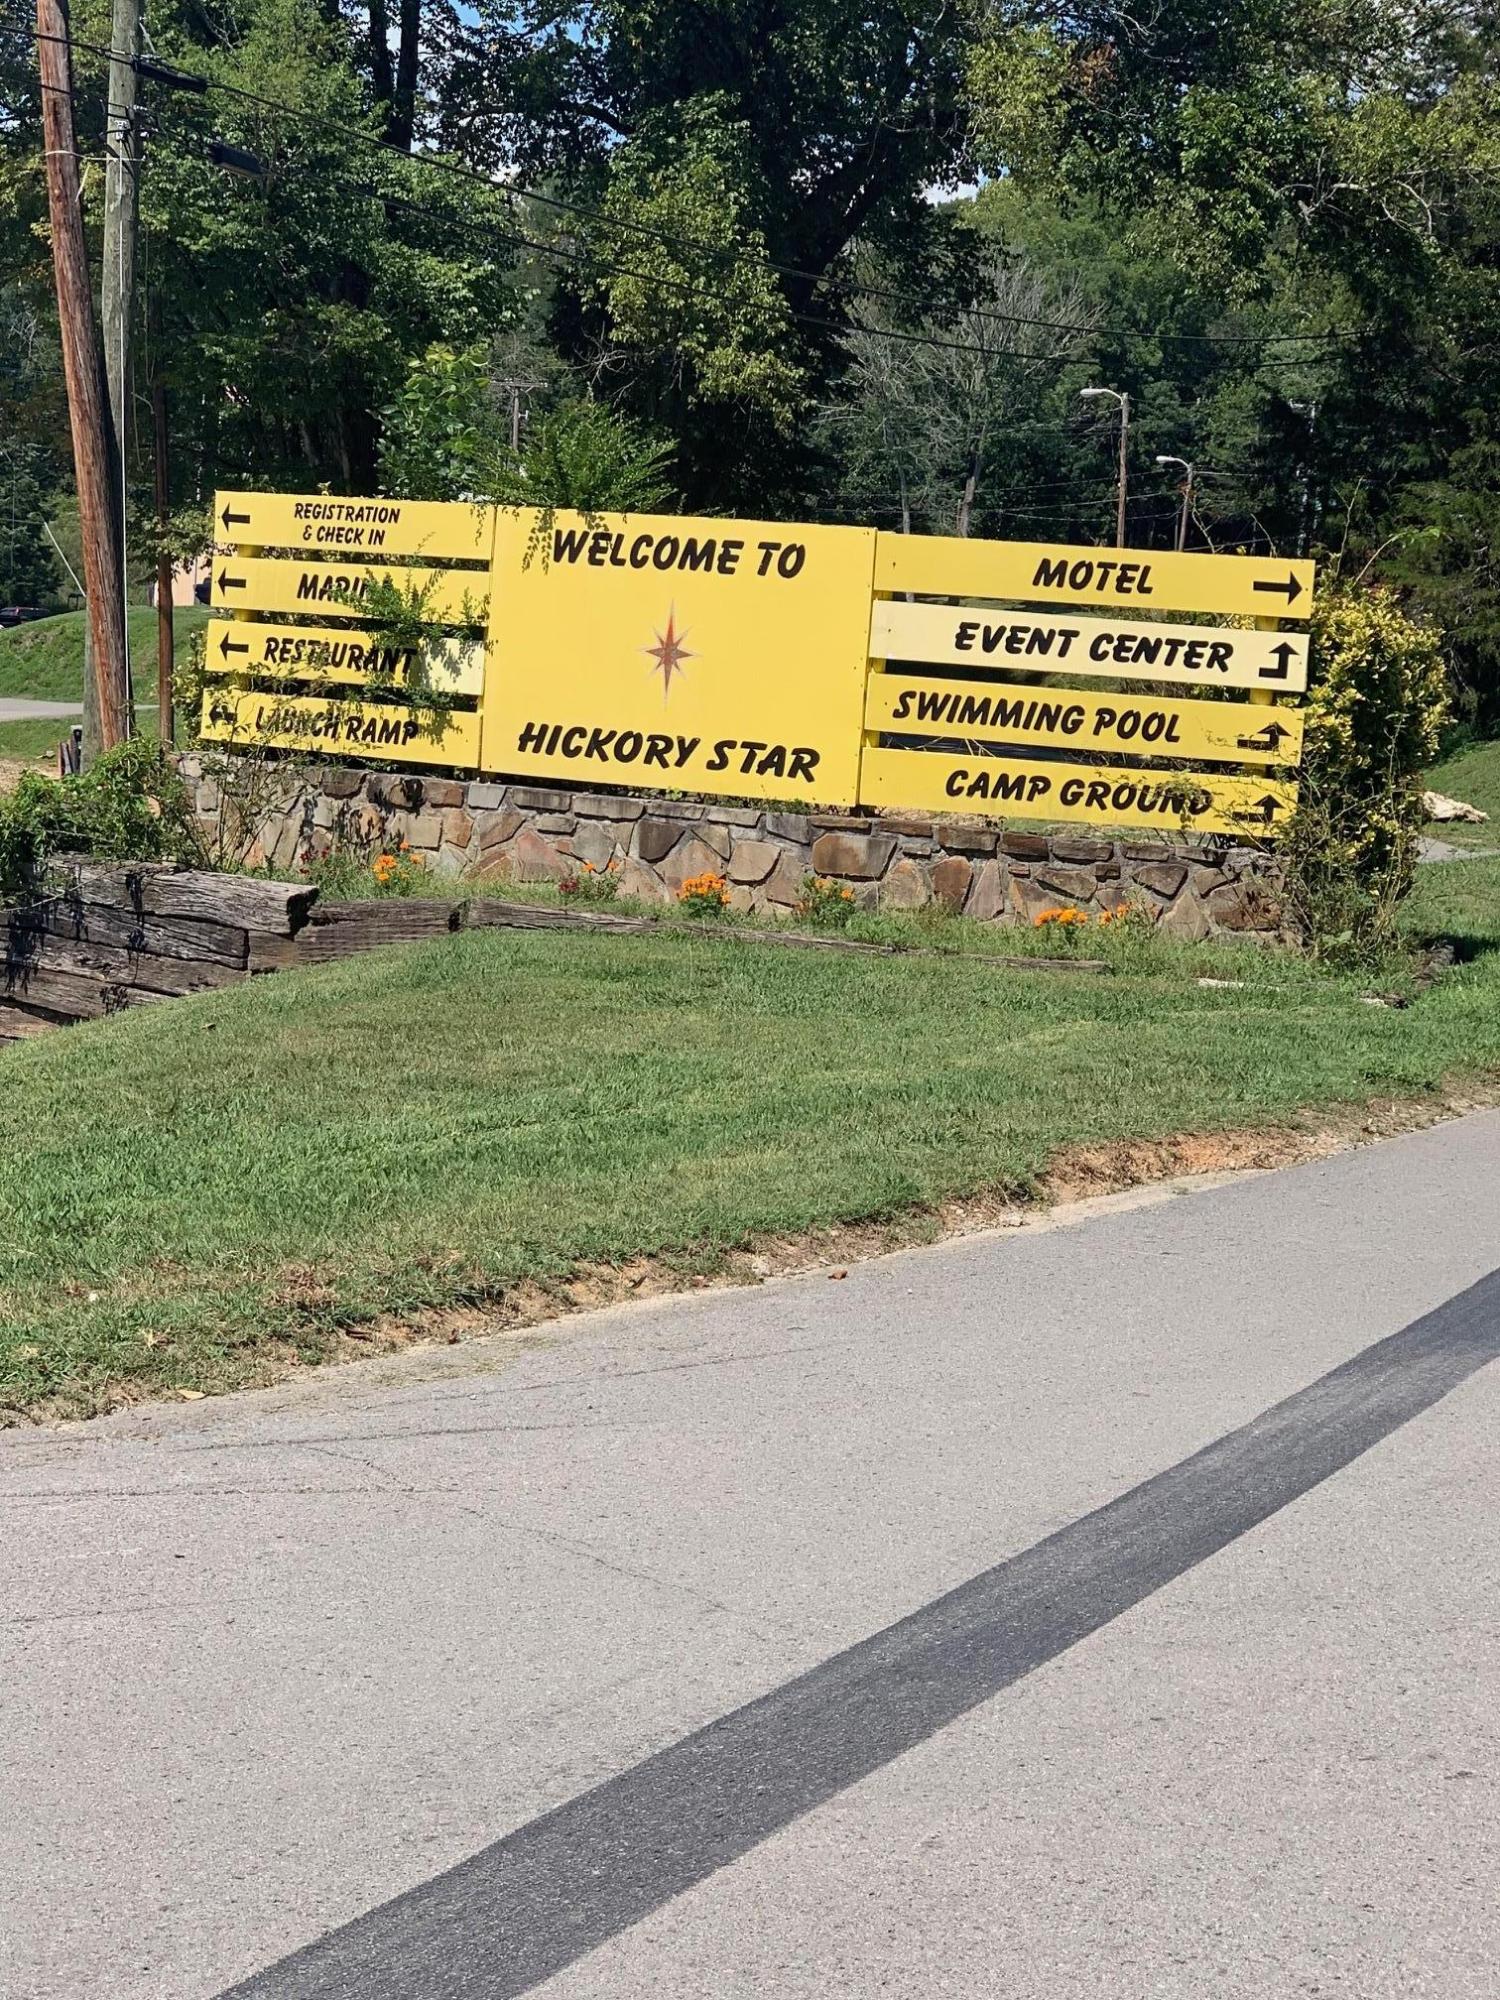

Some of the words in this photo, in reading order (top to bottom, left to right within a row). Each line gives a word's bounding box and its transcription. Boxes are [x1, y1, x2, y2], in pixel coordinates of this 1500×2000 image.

[294, 502, 401, 524] REGISTRATION
[303, 525, 313, 541] &
[317, 526, 363, 545] CHECK
[368, 529, 385, 546] IN
[552, 528, 744, 575] WELCOME
[756, 541, 806, 579] TO
[296, 573, 384, 605] MARI
[1032, 557, 1154, 595] MOTEL
[955, 622, 1080, 659] EVENT
[1088, 633, 1234, 673] CENTER
[344, 715, 419, 746] RAMP
[893, 690, 1085, 735] SWIMMING
[1093, 707, 1181, 743] POOL
[517, 721, 701, 769] HICKORY
[706, 740, 821, 783] STAR
[945, 770, 1052, 803] CAMP
[1060, 779, 1214, 815] GROUND
